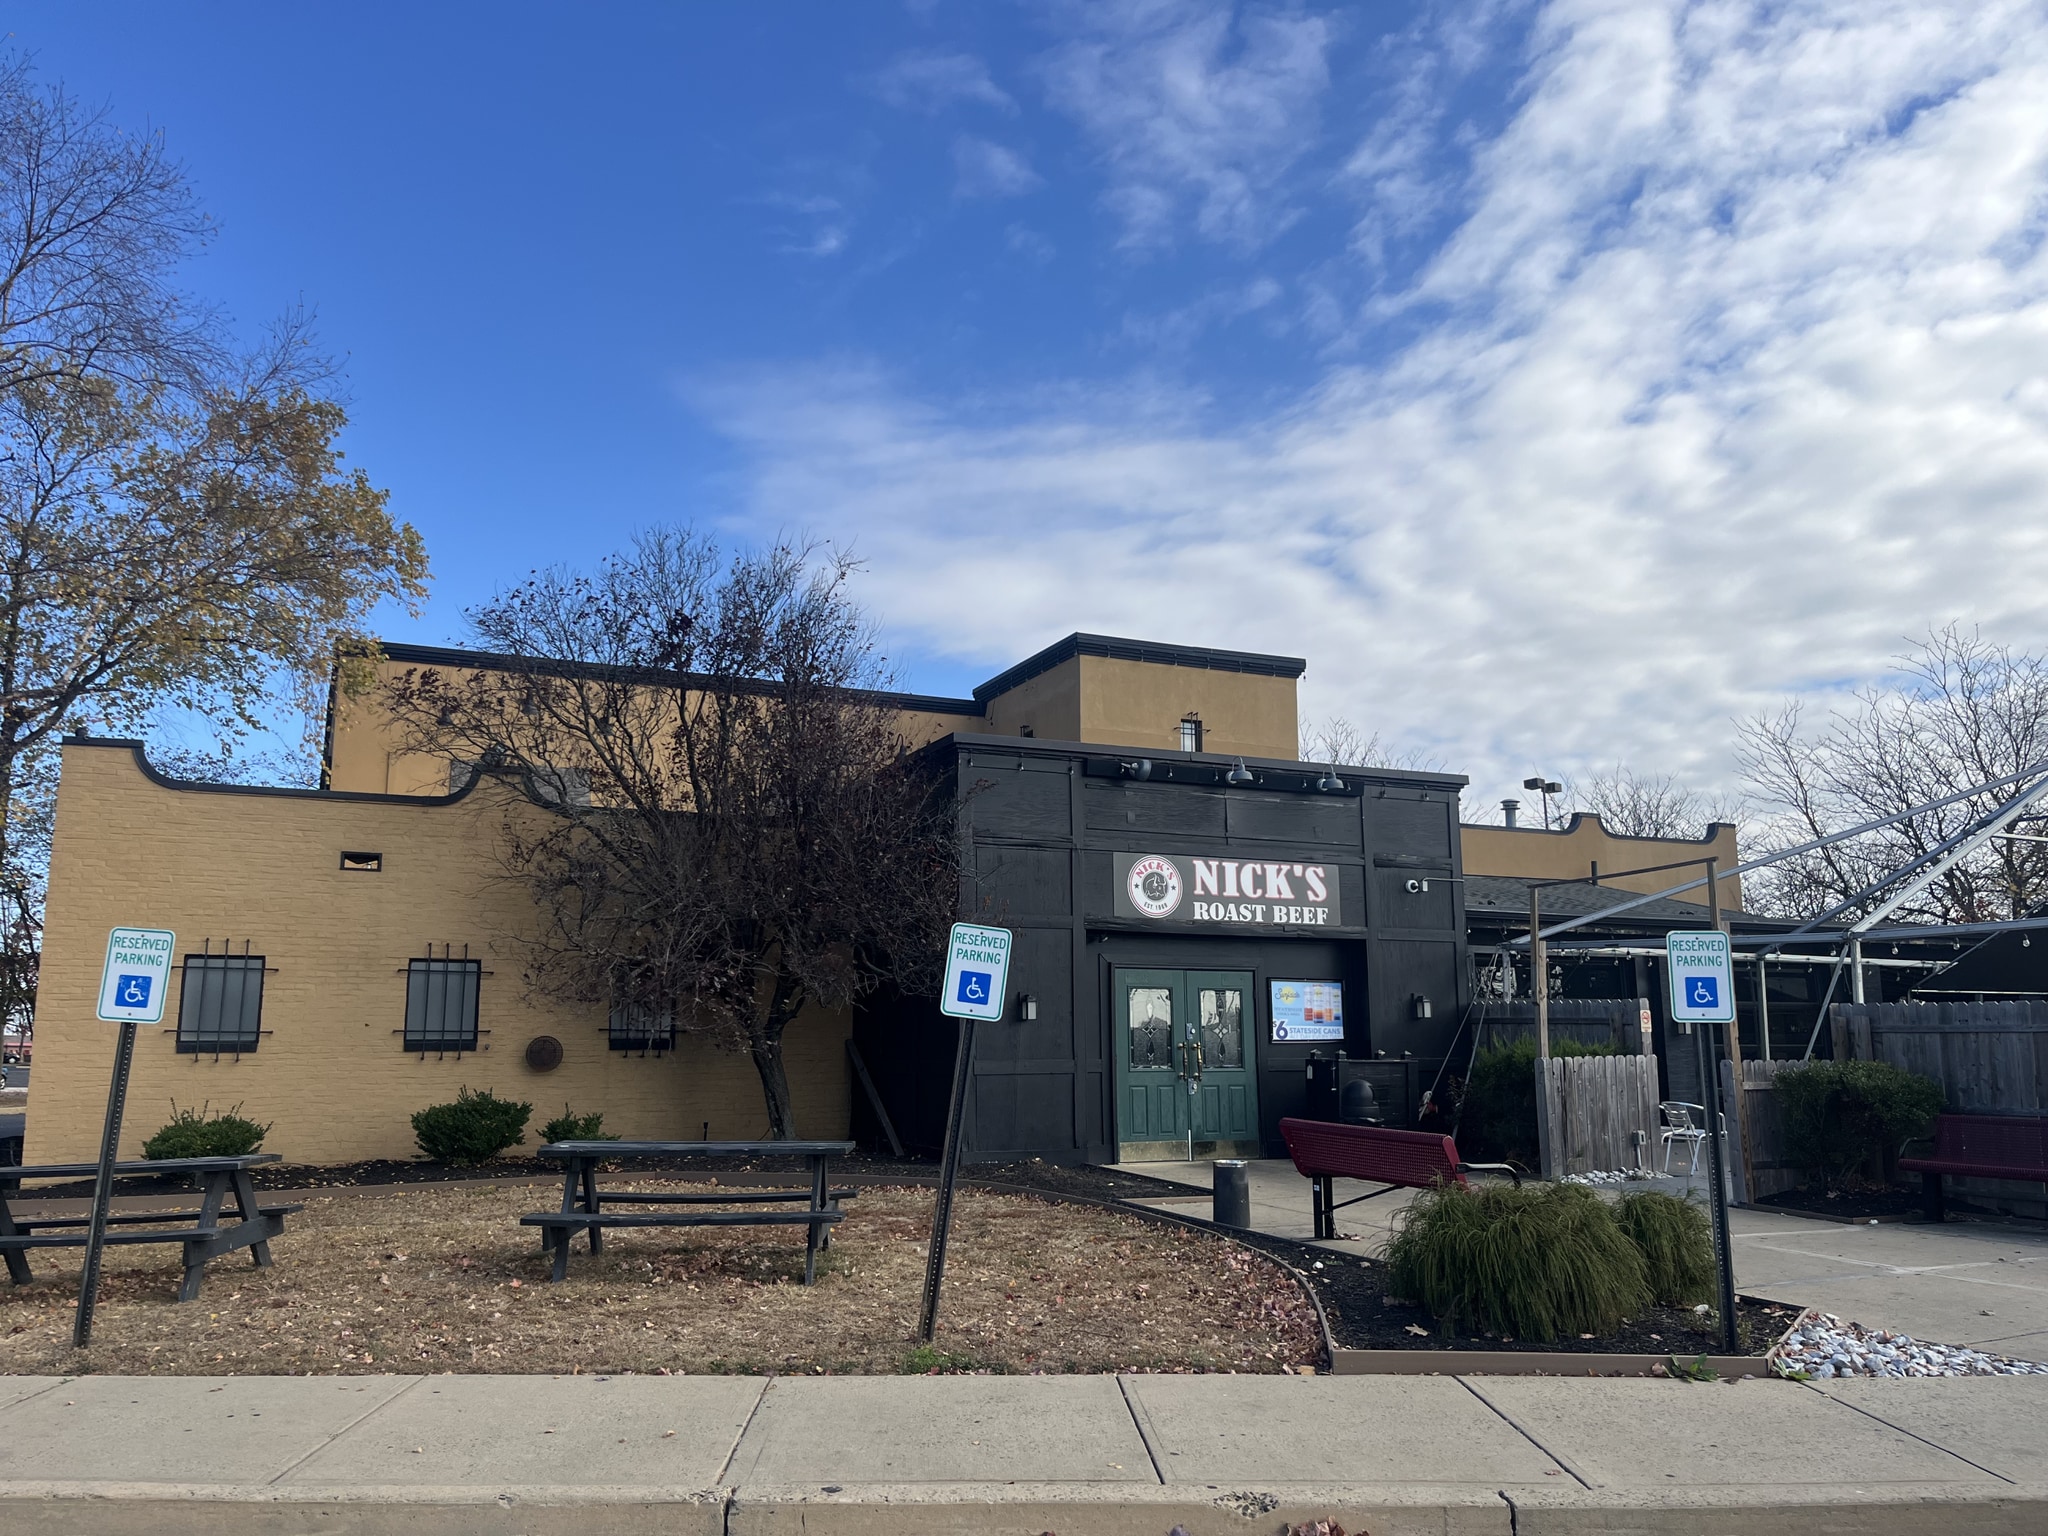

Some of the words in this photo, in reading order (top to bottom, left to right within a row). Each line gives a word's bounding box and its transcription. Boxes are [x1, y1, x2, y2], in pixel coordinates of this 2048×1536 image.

[1135, 861, 1175, 880] NICK'S
[1192, 859, 1328, 902] NICK'S
[1192, 901, 1267, 922] ROAST
[1272, 905, 1329, 925] BEEF
[113, 936, 169, 951] RESERVED
[955, 932, 1007, 950] RESERVED
[1671, 940, 1725, 952] RESERVED
[114, 952, 163, 966] PARKING
[956, 948, 1001, 965] PARKING
[1676, 955, 1723, 967] PARKING
[1289, 1027, 1322, 1035] STATESIDE
[1323, 1027, 1341, 1035] CANS
